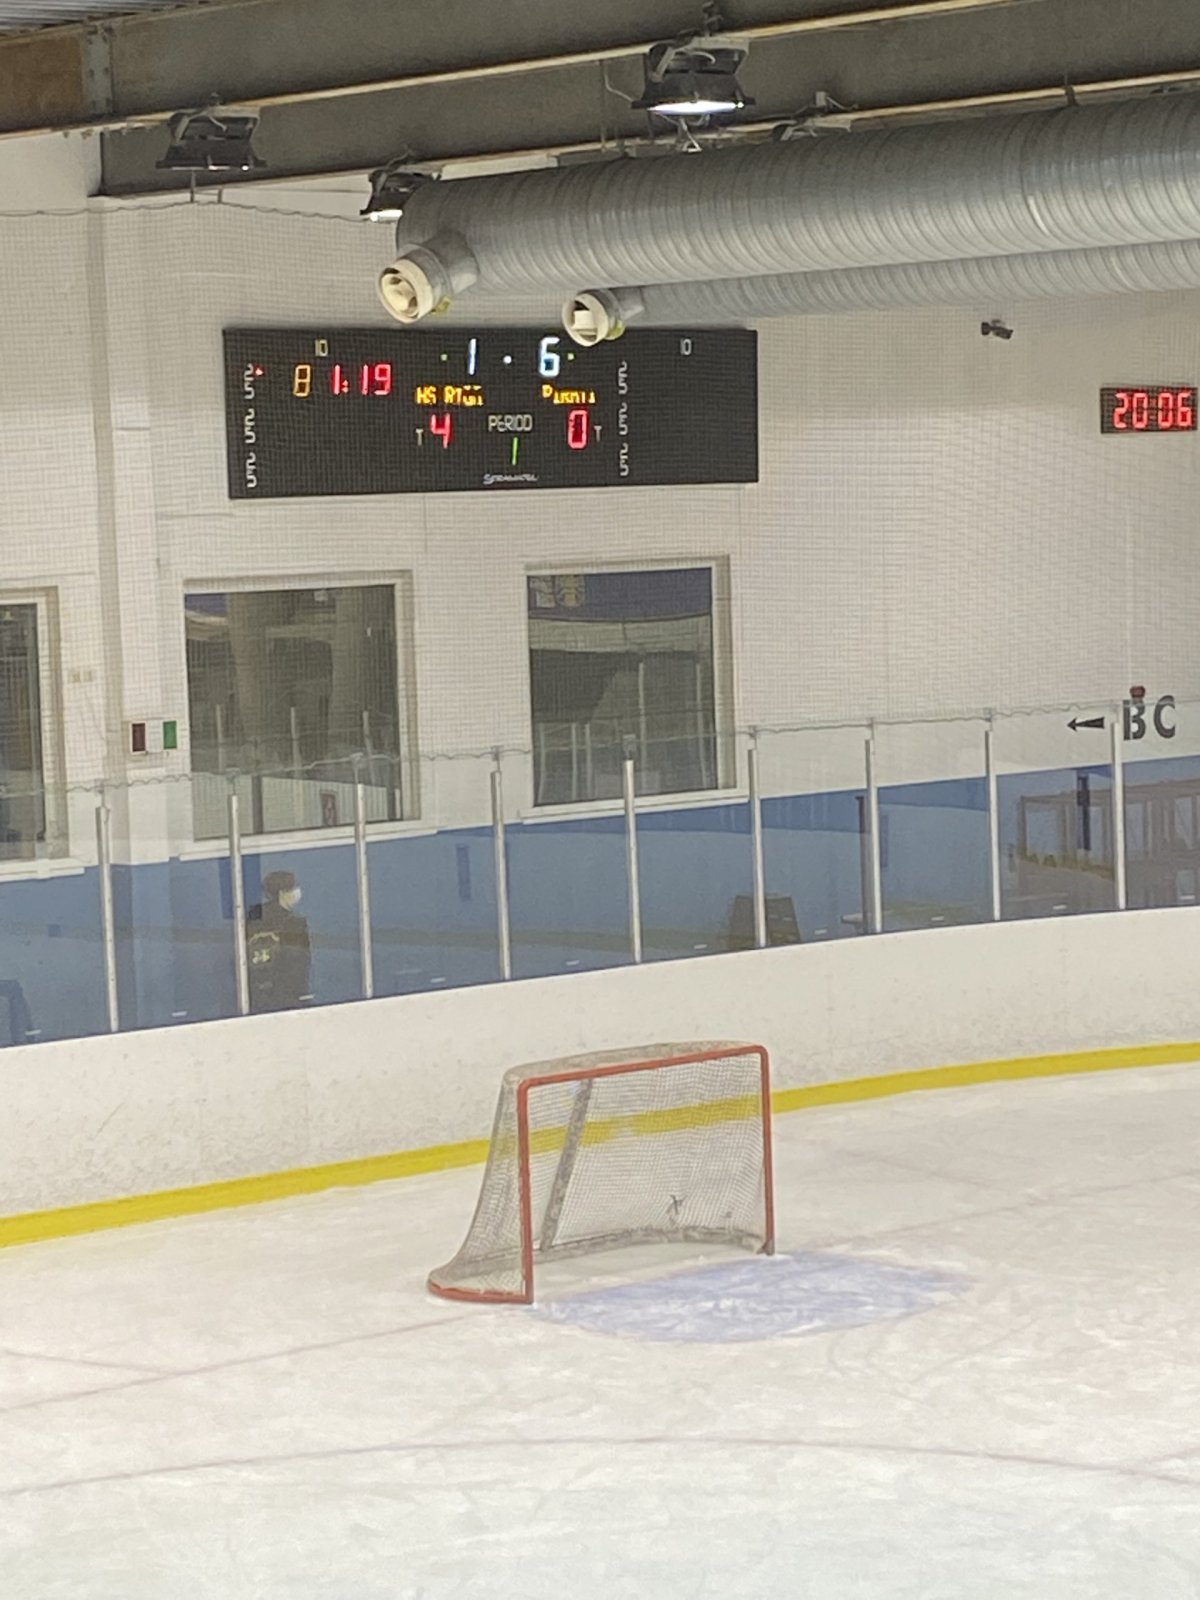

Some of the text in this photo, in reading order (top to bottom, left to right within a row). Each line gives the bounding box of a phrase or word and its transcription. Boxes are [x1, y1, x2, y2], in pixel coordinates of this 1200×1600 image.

[293, 363, 391, 397] 8 1:19
[487, 413, 534, 432] PERIOD
[1113, 391, 1192, 429] 20:06
[430, 413, 452, 449] 4
[567, 409, 589, 449] 0
